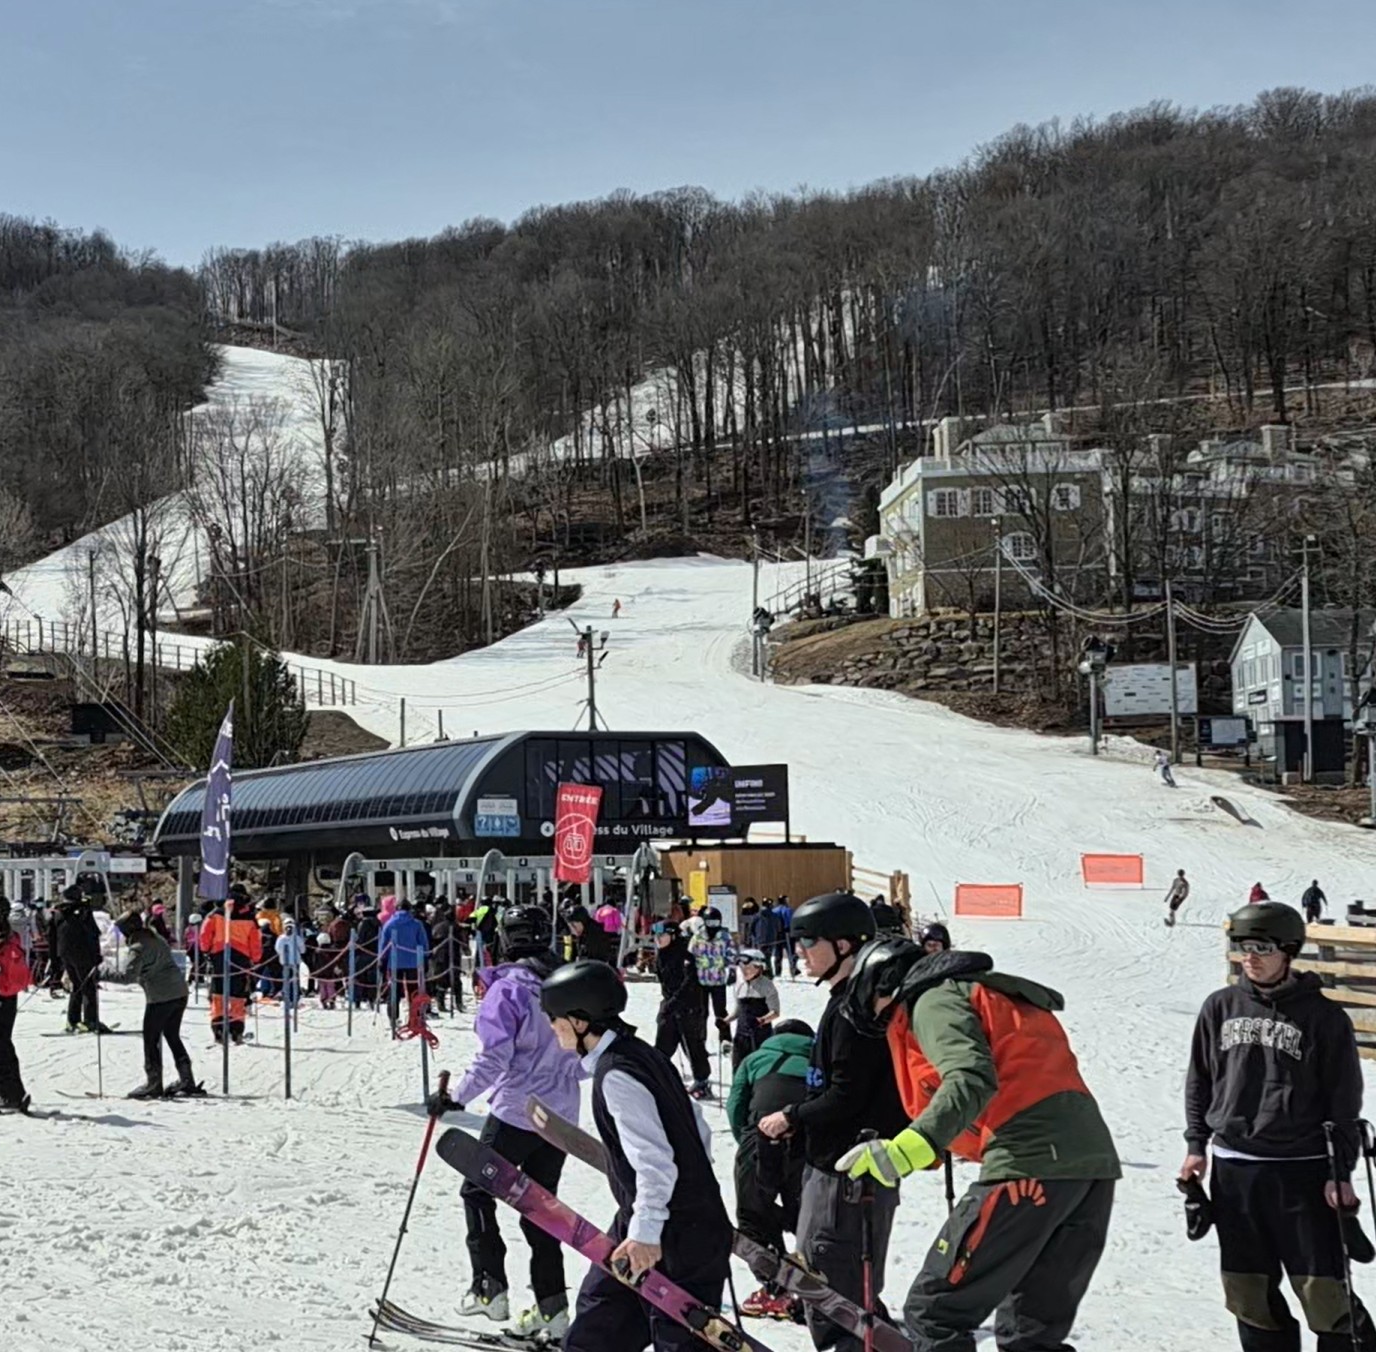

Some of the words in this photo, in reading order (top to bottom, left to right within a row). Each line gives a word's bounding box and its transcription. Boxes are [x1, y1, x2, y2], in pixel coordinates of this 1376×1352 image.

[561, 793, 599, 805] ENTRÉE
[612, 824, 628, 835] du
[631, 824, 674, 837] Village
[1220, 1016, 1302, 1061] HERSCHEL
